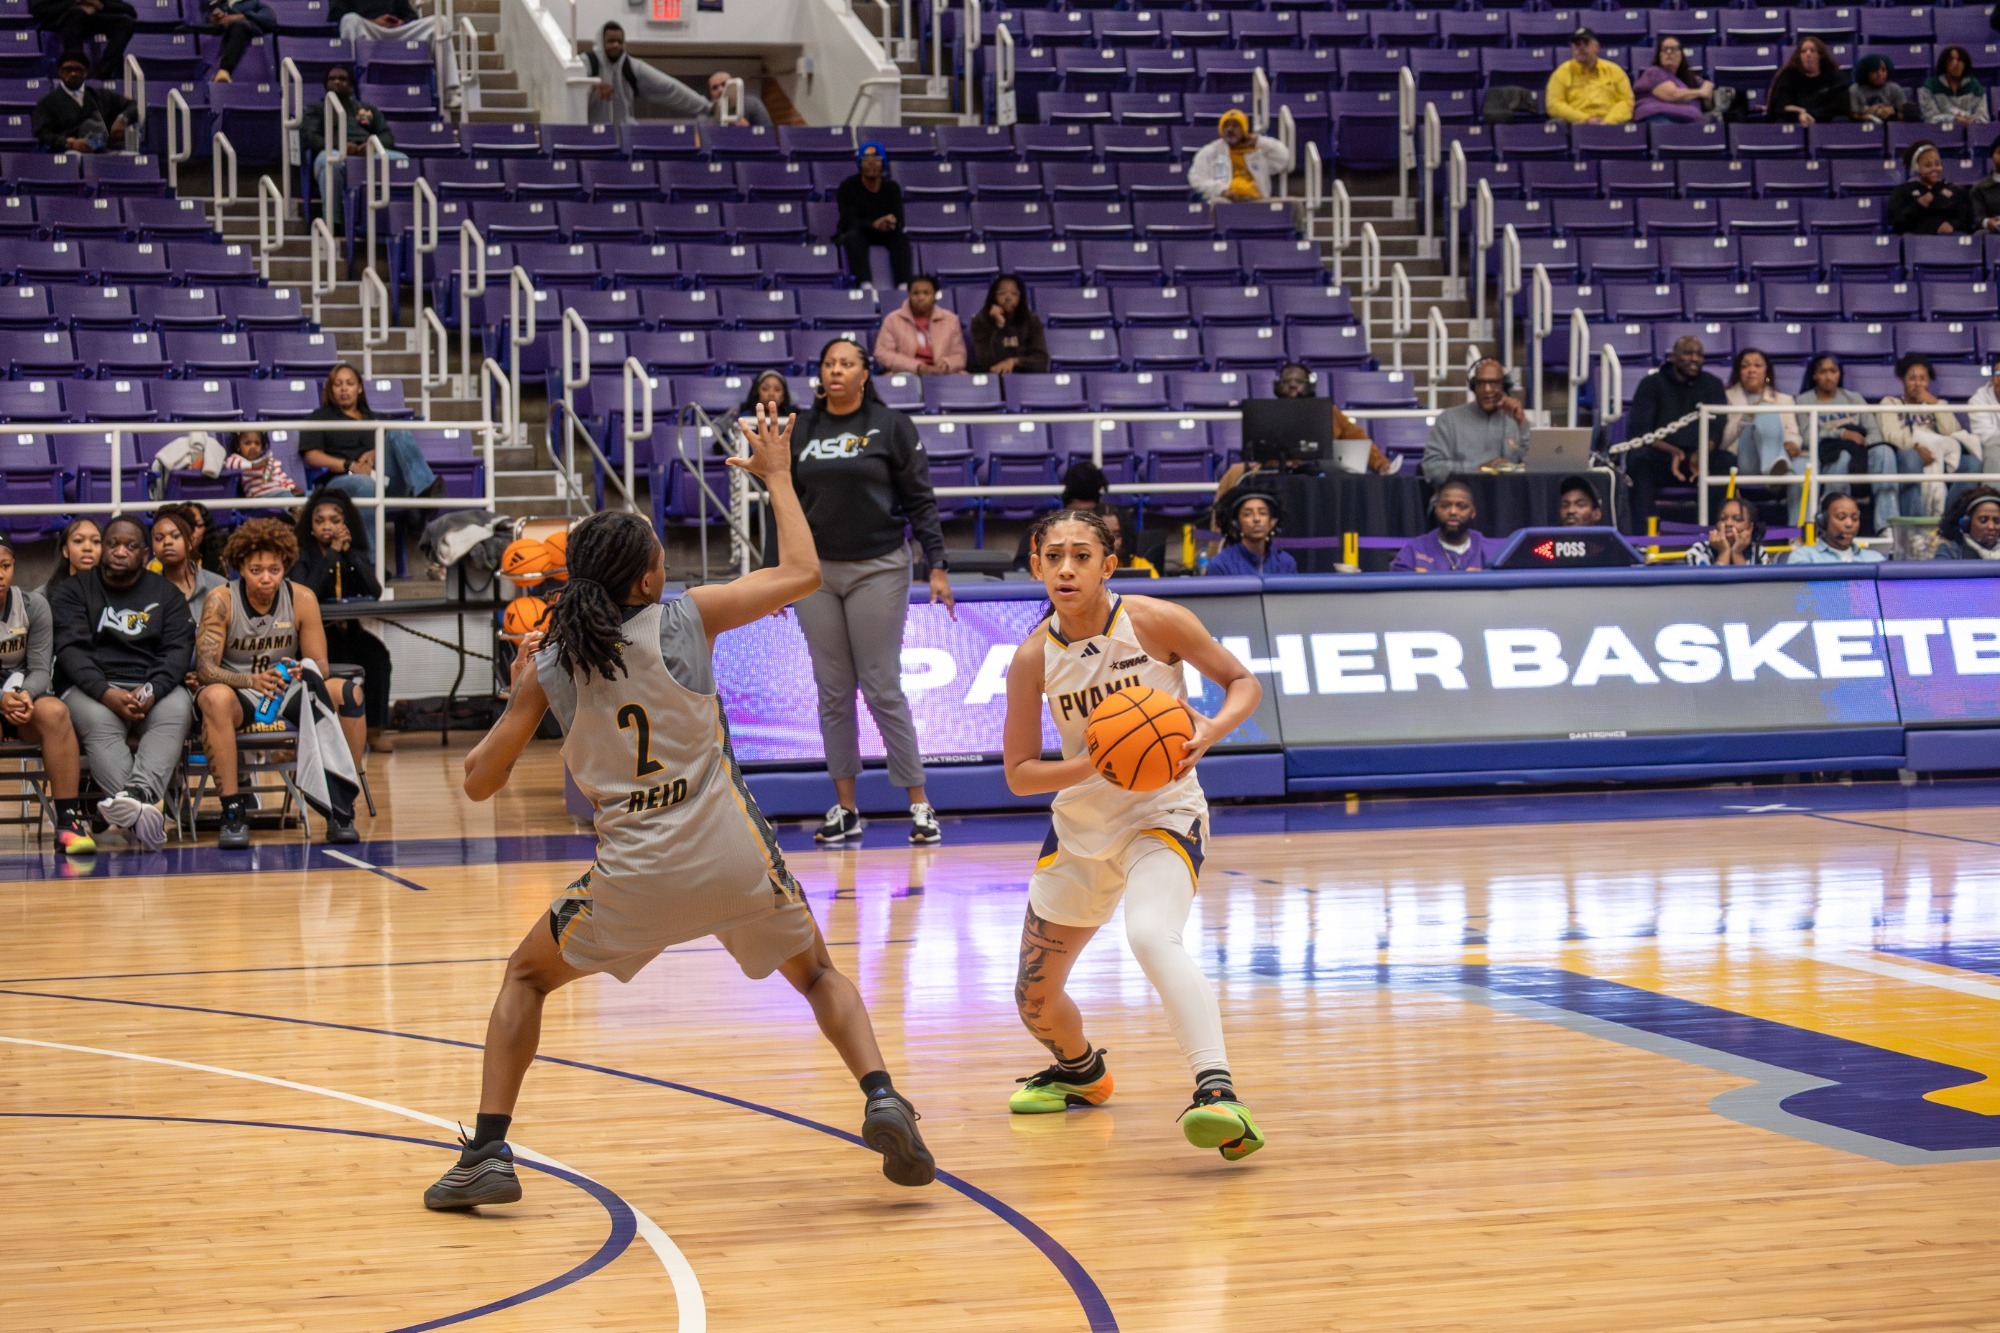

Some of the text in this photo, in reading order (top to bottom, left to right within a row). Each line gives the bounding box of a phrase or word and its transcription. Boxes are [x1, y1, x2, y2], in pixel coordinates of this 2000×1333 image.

[1555, 541, 1586, 557] POSS
[230, 635, 293, 651] ALABAMA
[616, 702, 666, 777] 2
[920, 755, 983, 763] DAKTRONICS
[626, 778, 688, 814] REID
